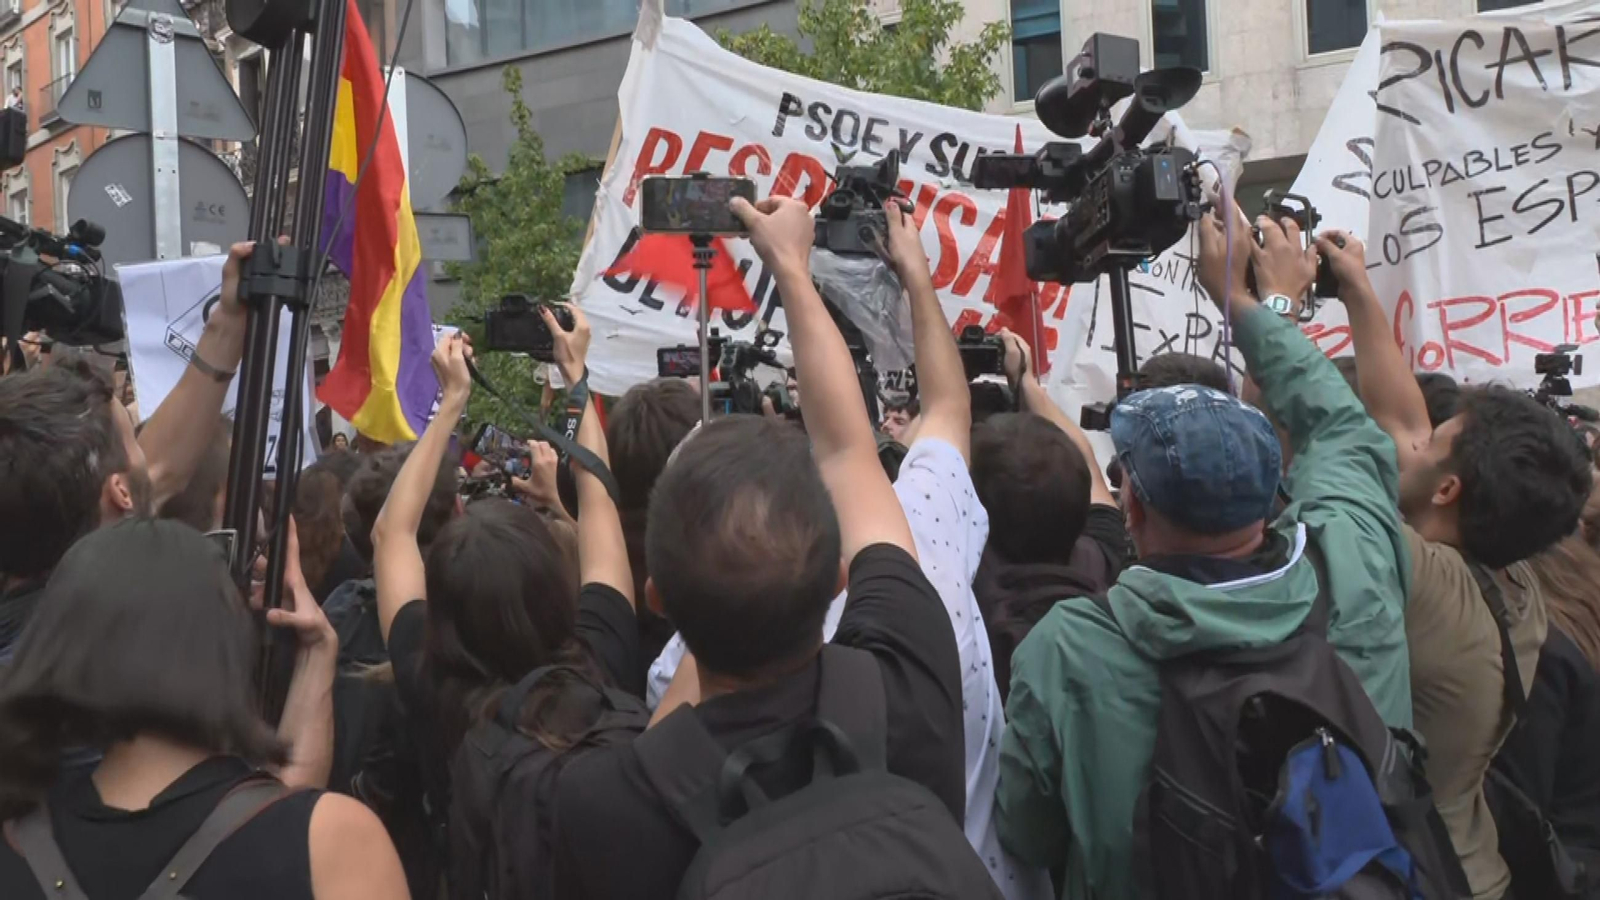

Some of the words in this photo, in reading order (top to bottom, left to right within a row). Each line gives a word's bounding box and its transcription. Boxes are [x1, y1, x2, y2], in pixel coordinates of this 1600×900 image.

[771, 91, 890, 157] PSOE
[899, 127, 924, 165] Y
[925, 132, 1007, 185] SU
[1373, 131, 1563, 199] CULPABLES
[1366, 205, 1444, 270] OS
[1467, 170, 1600, 249] ESP
[565, 417, 577, 441] SO
